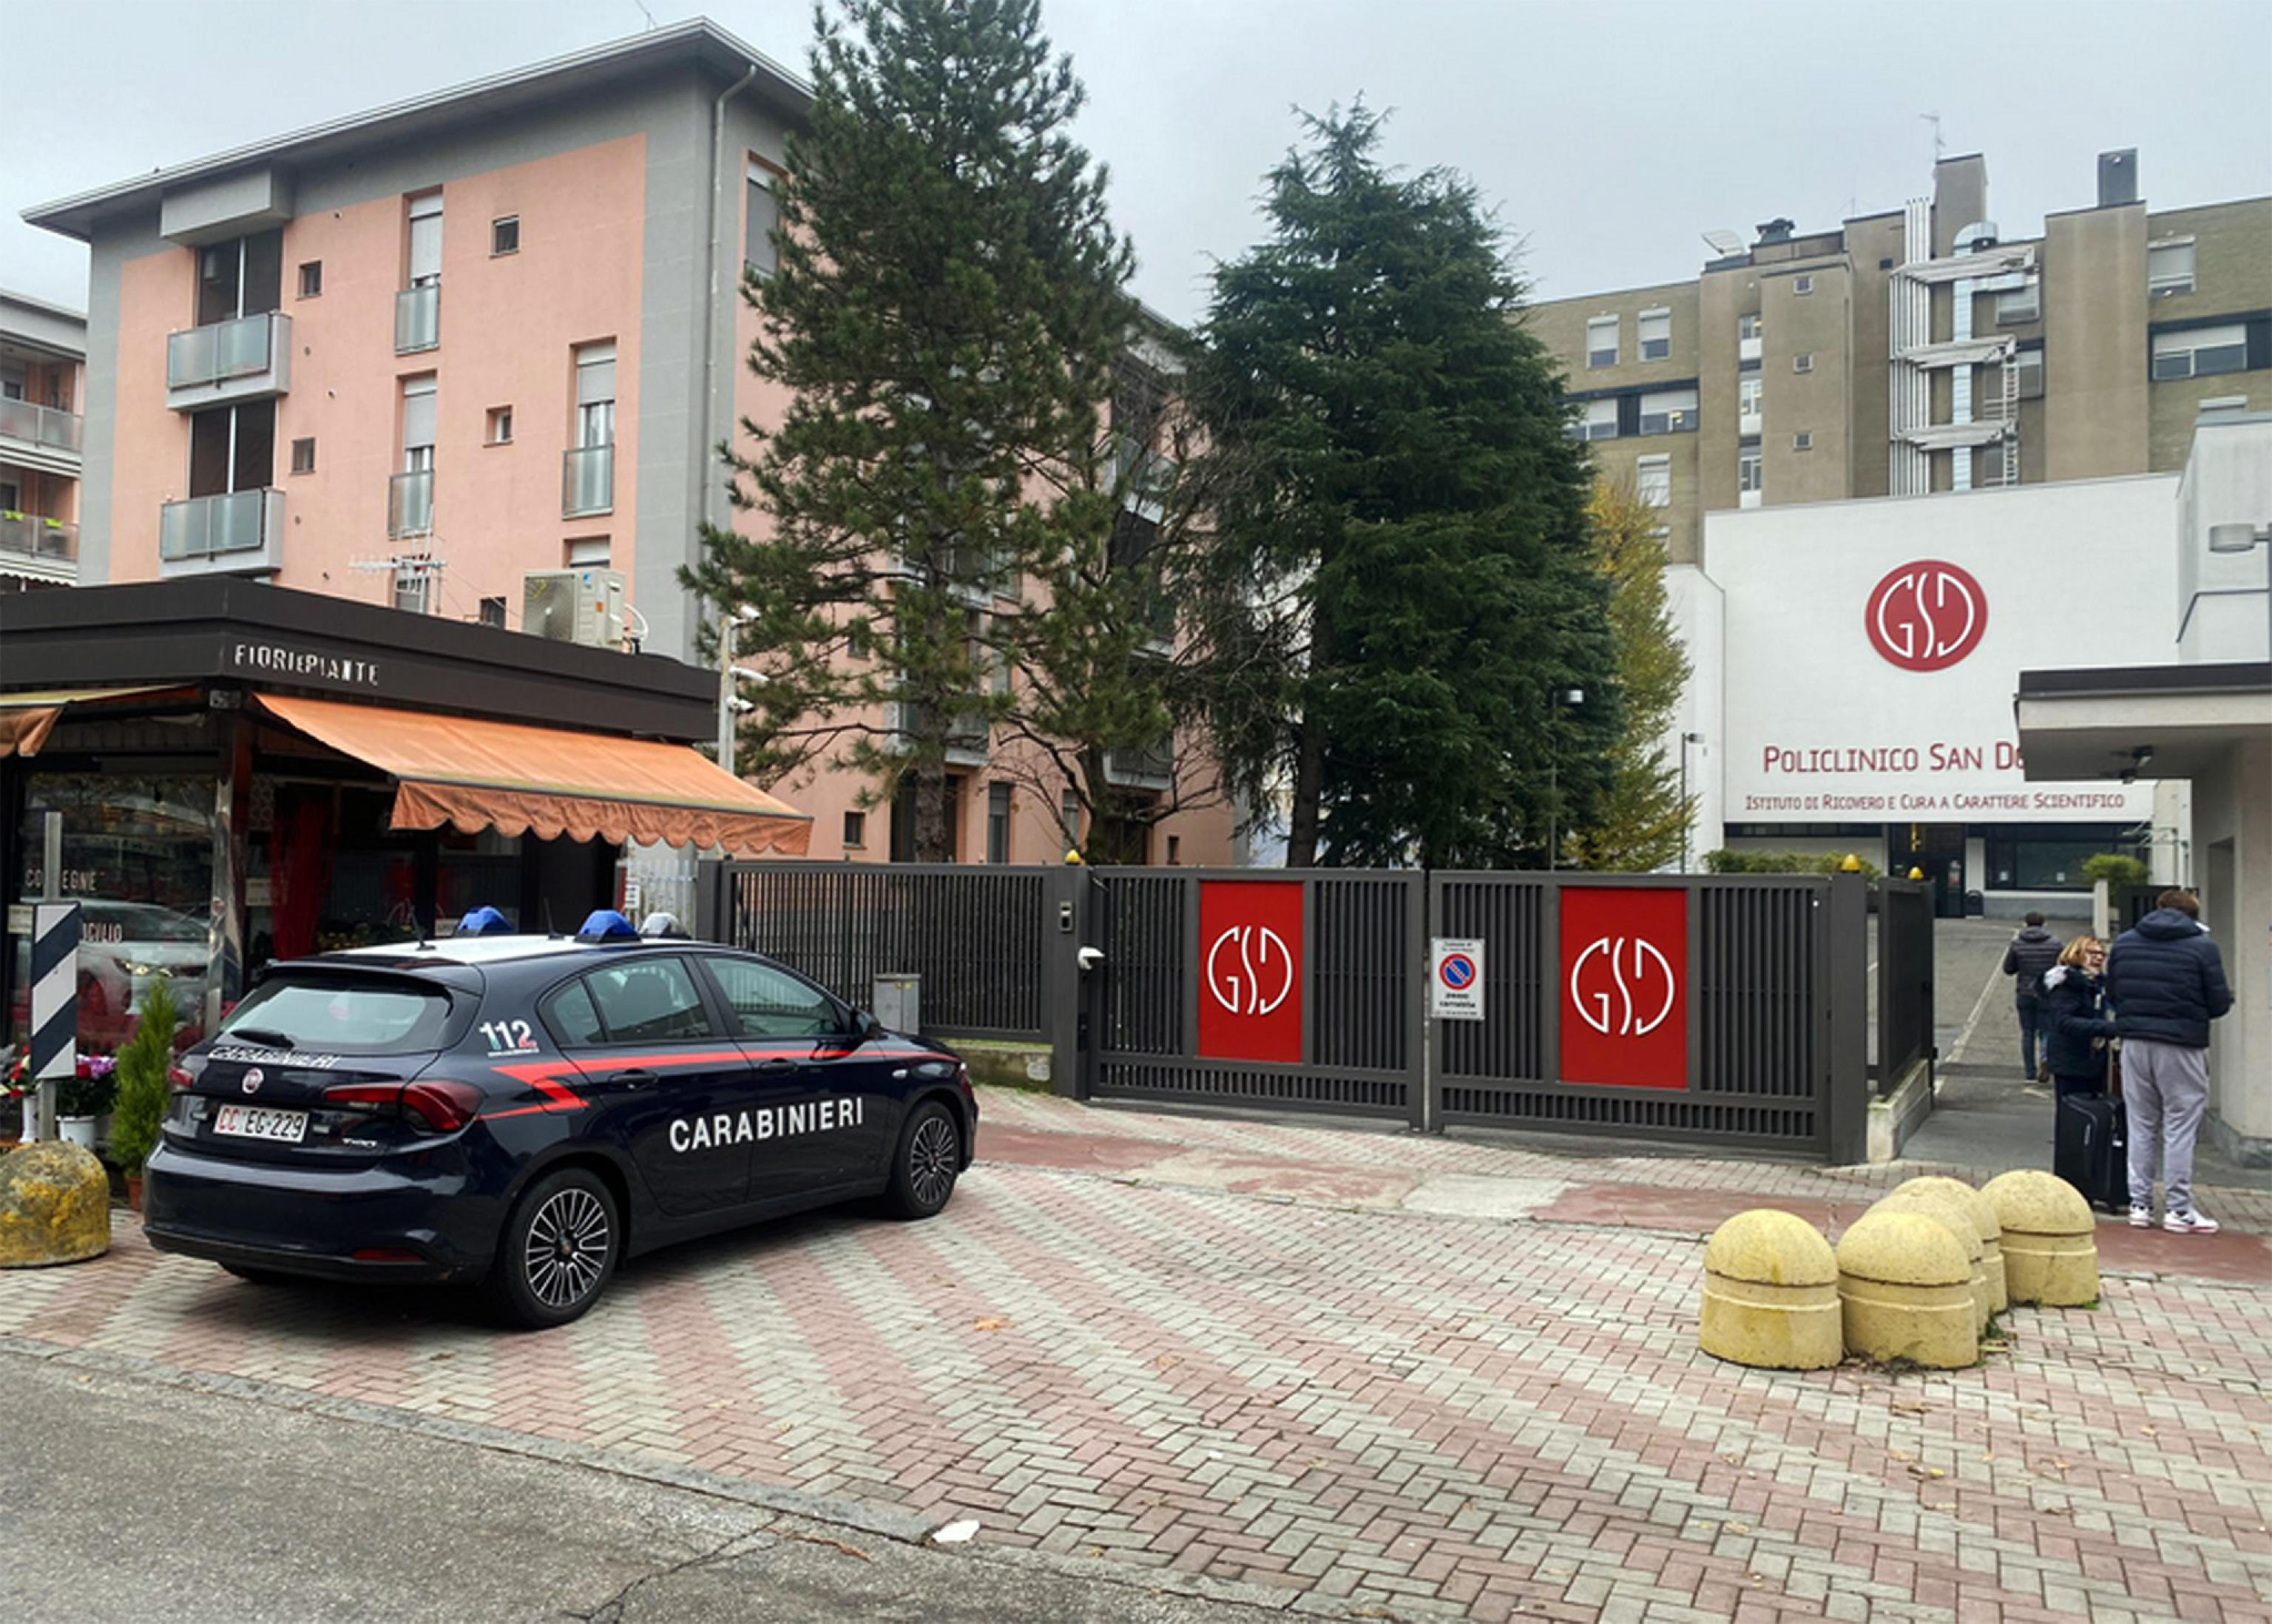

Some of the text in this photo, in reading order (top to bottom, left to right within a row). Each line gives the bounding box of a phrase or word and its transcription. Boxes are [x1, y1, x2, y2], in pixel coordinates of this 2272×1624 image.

[1877, 572, 1975, 659] GSD
[1929, 742, 1983, 771] SAN
[1746, 794, 1802, 811] ISTITUTO
[1822, 793, 1885, 811] RICOVERO
[1887, 796, 1896, 811] E
[1900, 792, 1937, 811] CURA
[1940, 794, 1950, 810] A
[1953, 791, 2029, 811] CARATTERE
[2034, 789, 2125, 809] SCIENTIFICO
[1207, 925, 1293, 1015] GSD
[1570, 936, 1675, 1036] GSD
[479, 1020, 538, 1050] 112
[669, 1096, 862, 1153] CARABINIERI
